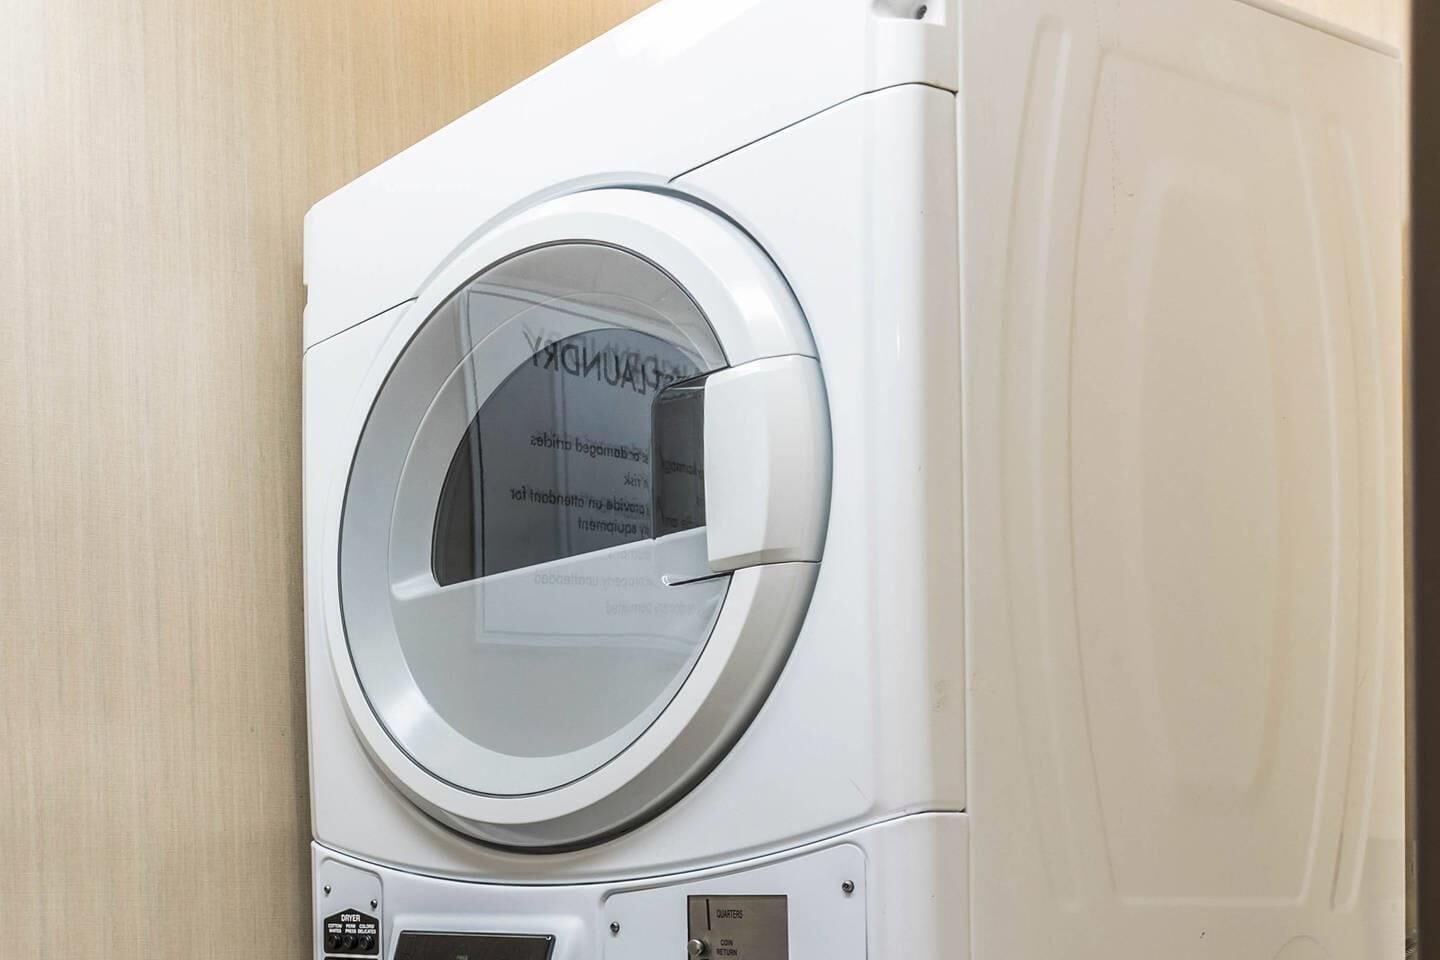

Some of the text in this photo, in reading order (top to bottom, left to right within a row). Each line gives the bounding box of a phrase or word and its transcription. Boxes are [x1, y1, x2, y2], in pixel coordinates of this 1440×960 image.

[340, 914, 361, 922] DRYER
[716, 909, 743, 919] QUARTERS
[716, 948, 738, 956] RETURN
